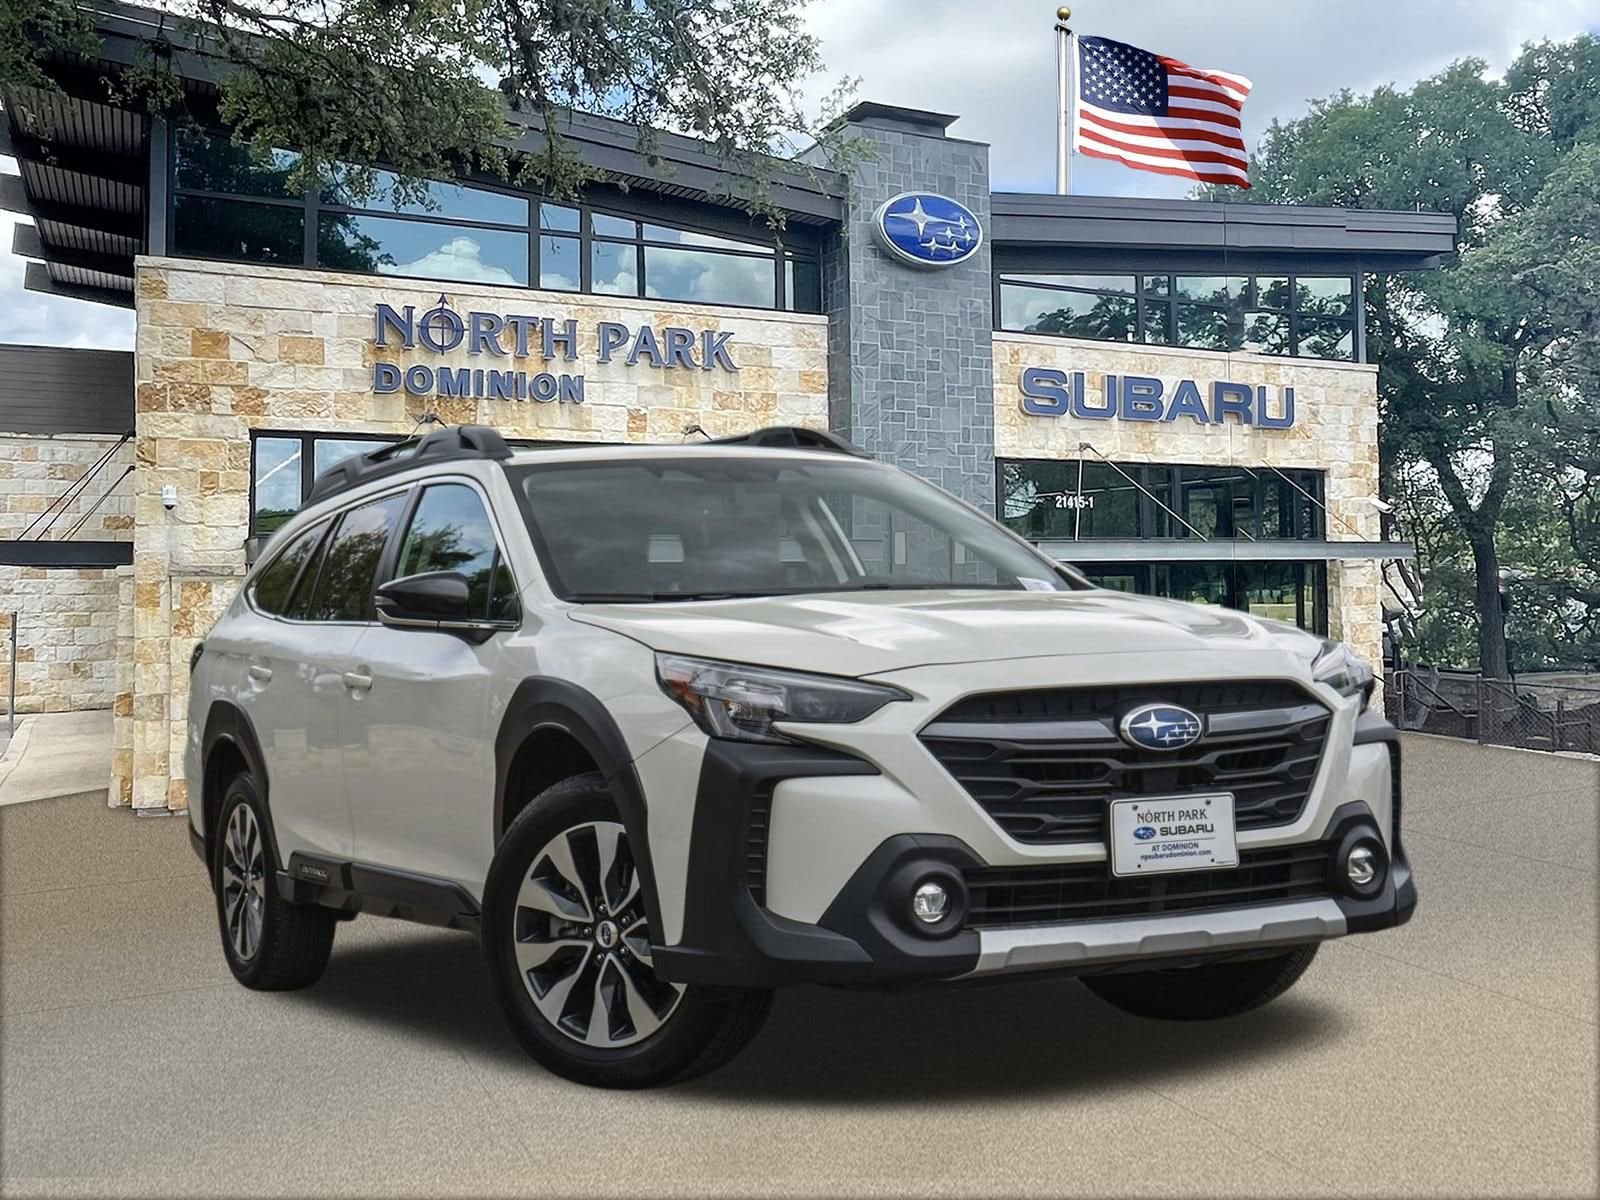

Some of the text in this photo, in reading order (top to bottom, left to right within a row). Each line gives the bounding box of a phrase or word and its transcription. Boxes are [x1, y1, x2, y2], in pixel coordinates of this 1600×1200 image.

[374, 299, 741, 373] NORTH PARK
[373, 361, 585, 404] DOMINION
[1019, 366, 1296, 430] SUBARU
[1055, 495, 1094, 509] 21415-1
[1136, 808, 1208, 824] NORTH PARK
[1160, 823, 1214, 836] SUBARU
[1151, 842, 1199, 852] AT DOMINION
